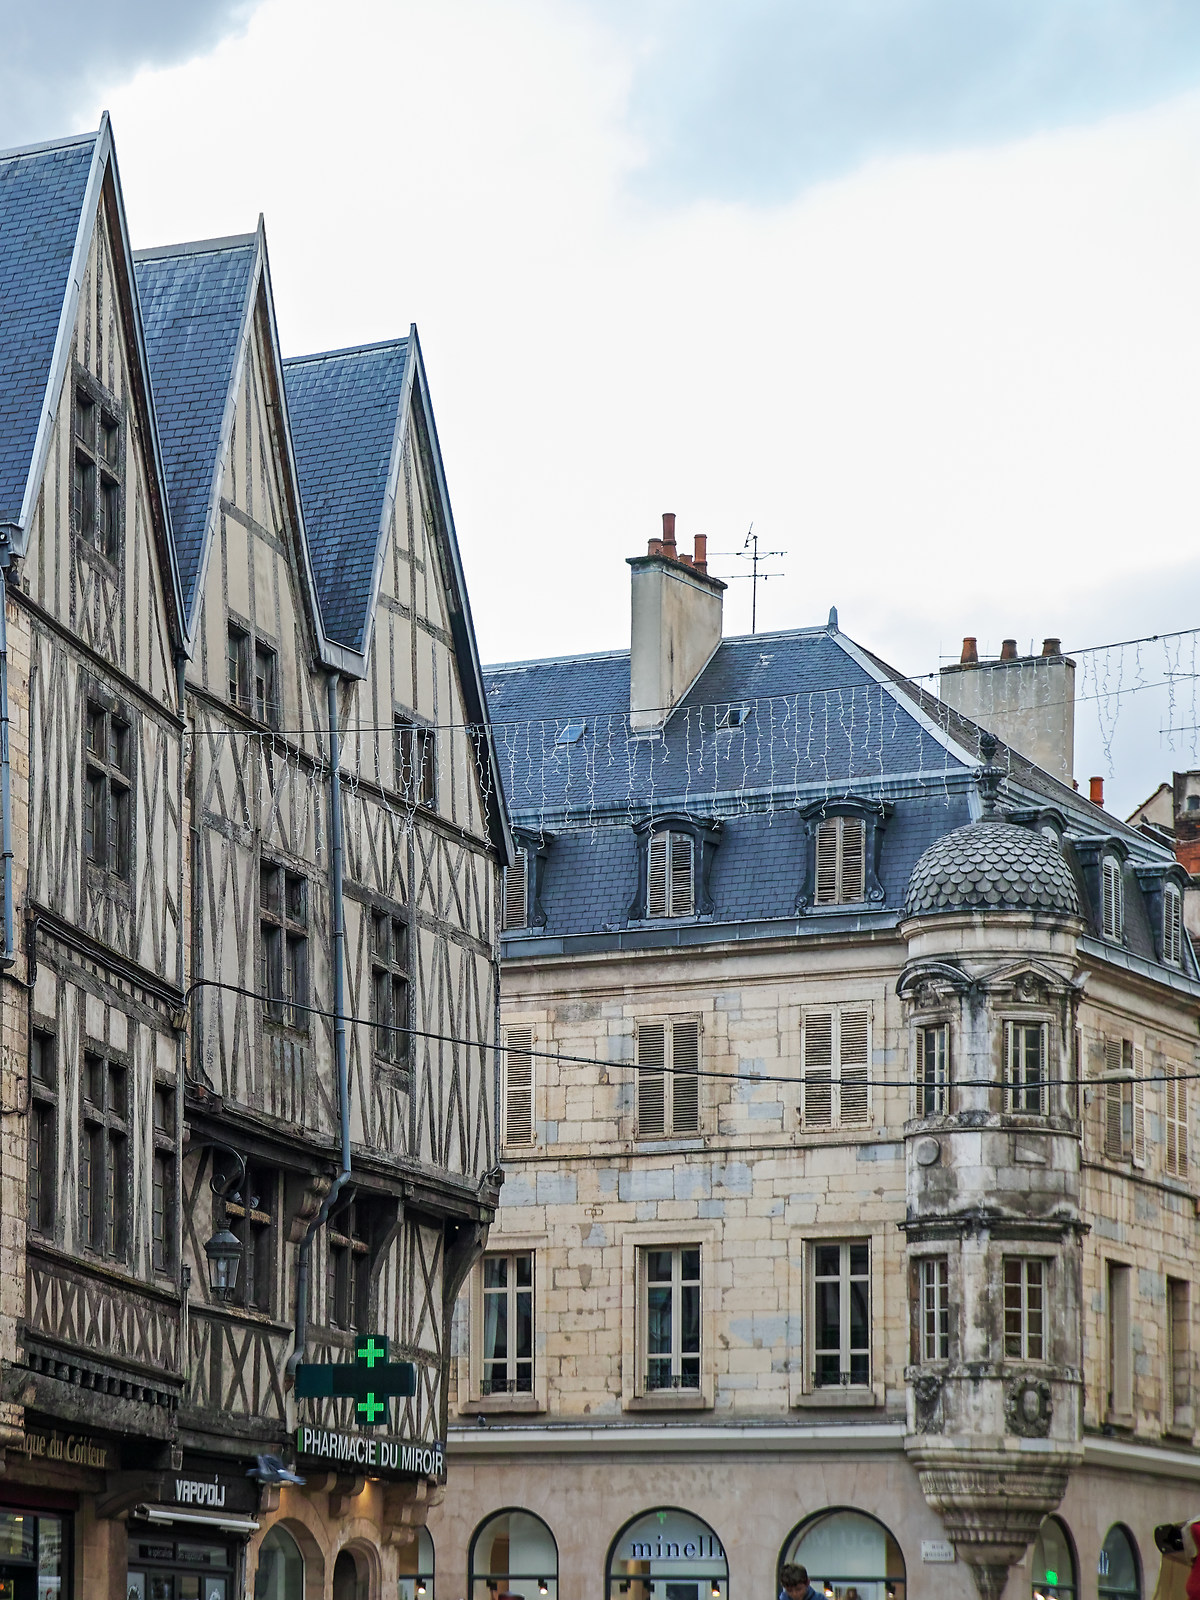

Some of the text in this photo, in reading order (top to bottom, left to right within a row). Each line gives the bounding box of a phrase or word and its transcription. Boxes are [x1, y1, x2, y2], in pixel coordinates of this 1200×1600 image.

[47, 1429, 63, 1460] du
[303, 1427, 444, 1476] PHARMACIE DU MIROIR
